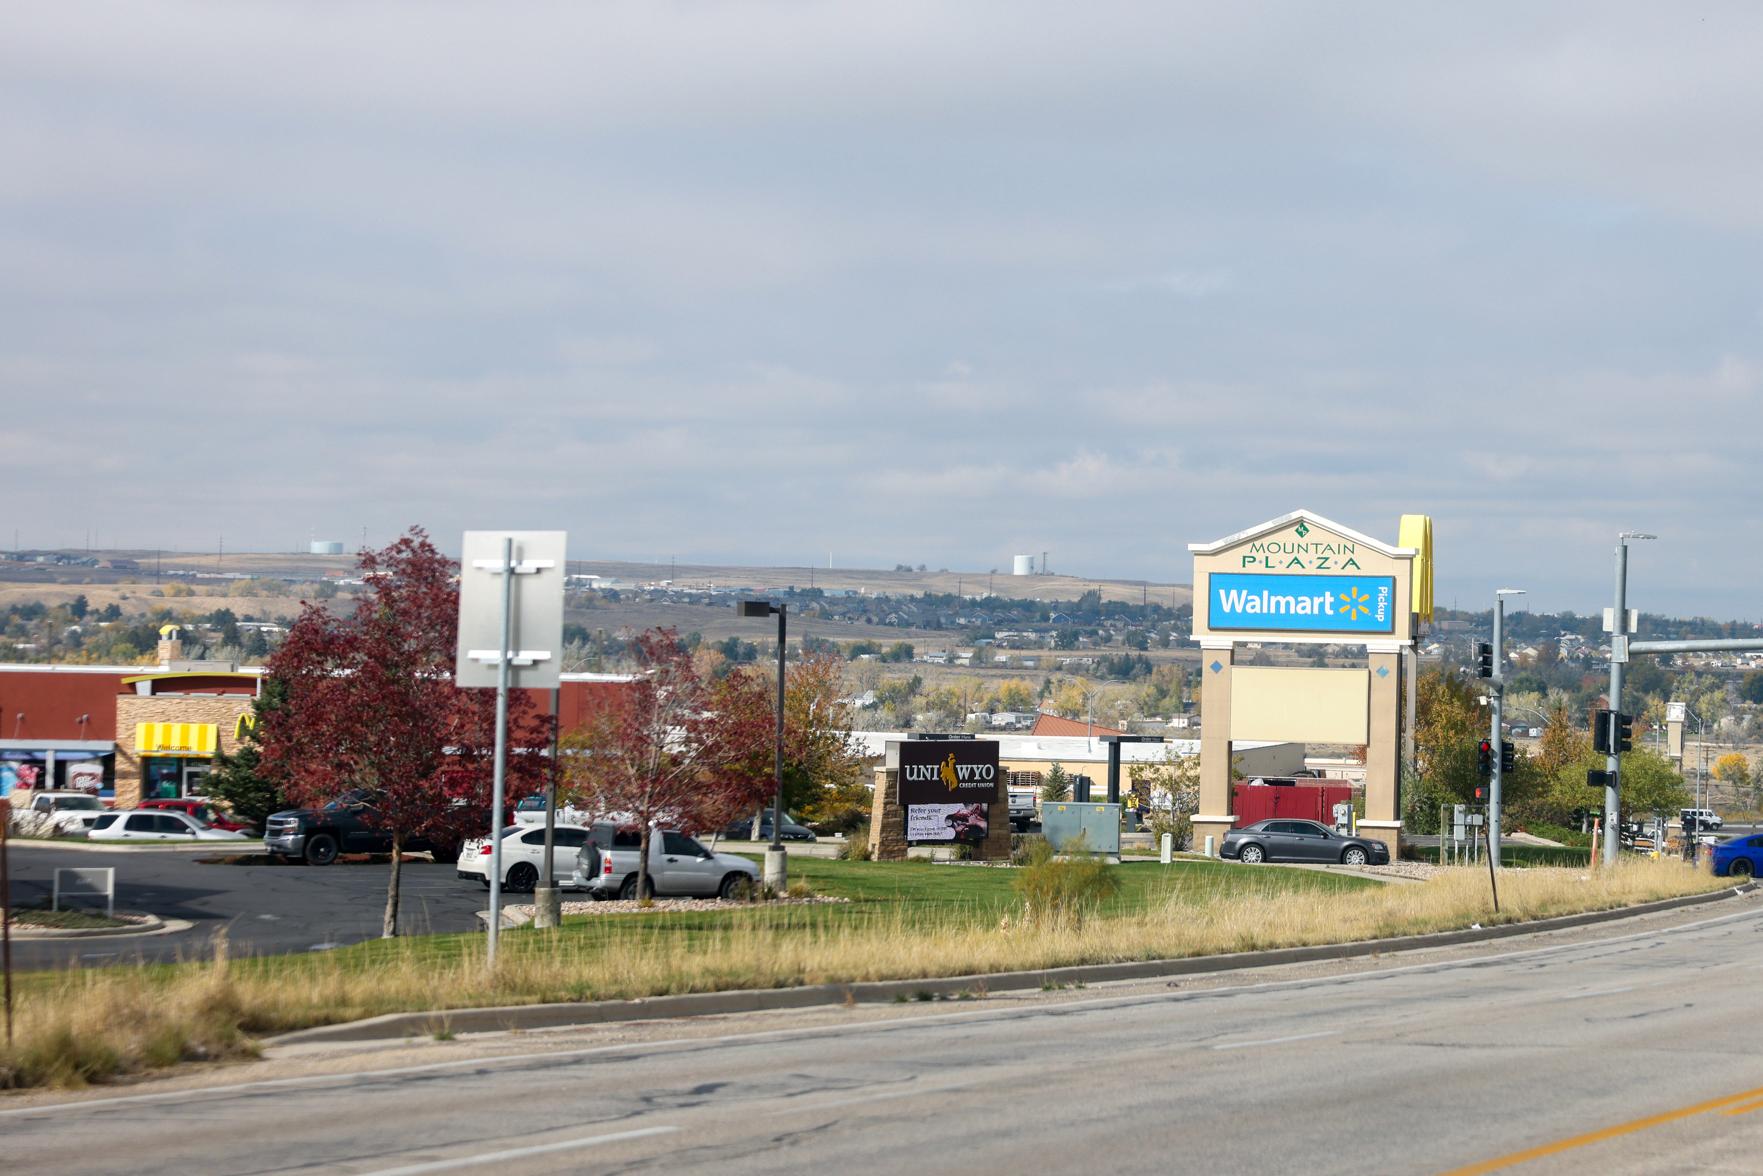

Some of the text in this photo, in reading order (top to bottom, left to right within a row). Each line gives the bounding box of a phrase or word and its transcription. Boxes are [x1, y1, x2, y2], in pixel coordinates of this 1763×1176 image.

[1249, 542, 1355, 554] MOUNTAIN
[1219, 589, 1335, 615] Walmart
[1375, 586, 1389, 622] Pickup
[905, 764, 994, 780] UNI WYO
